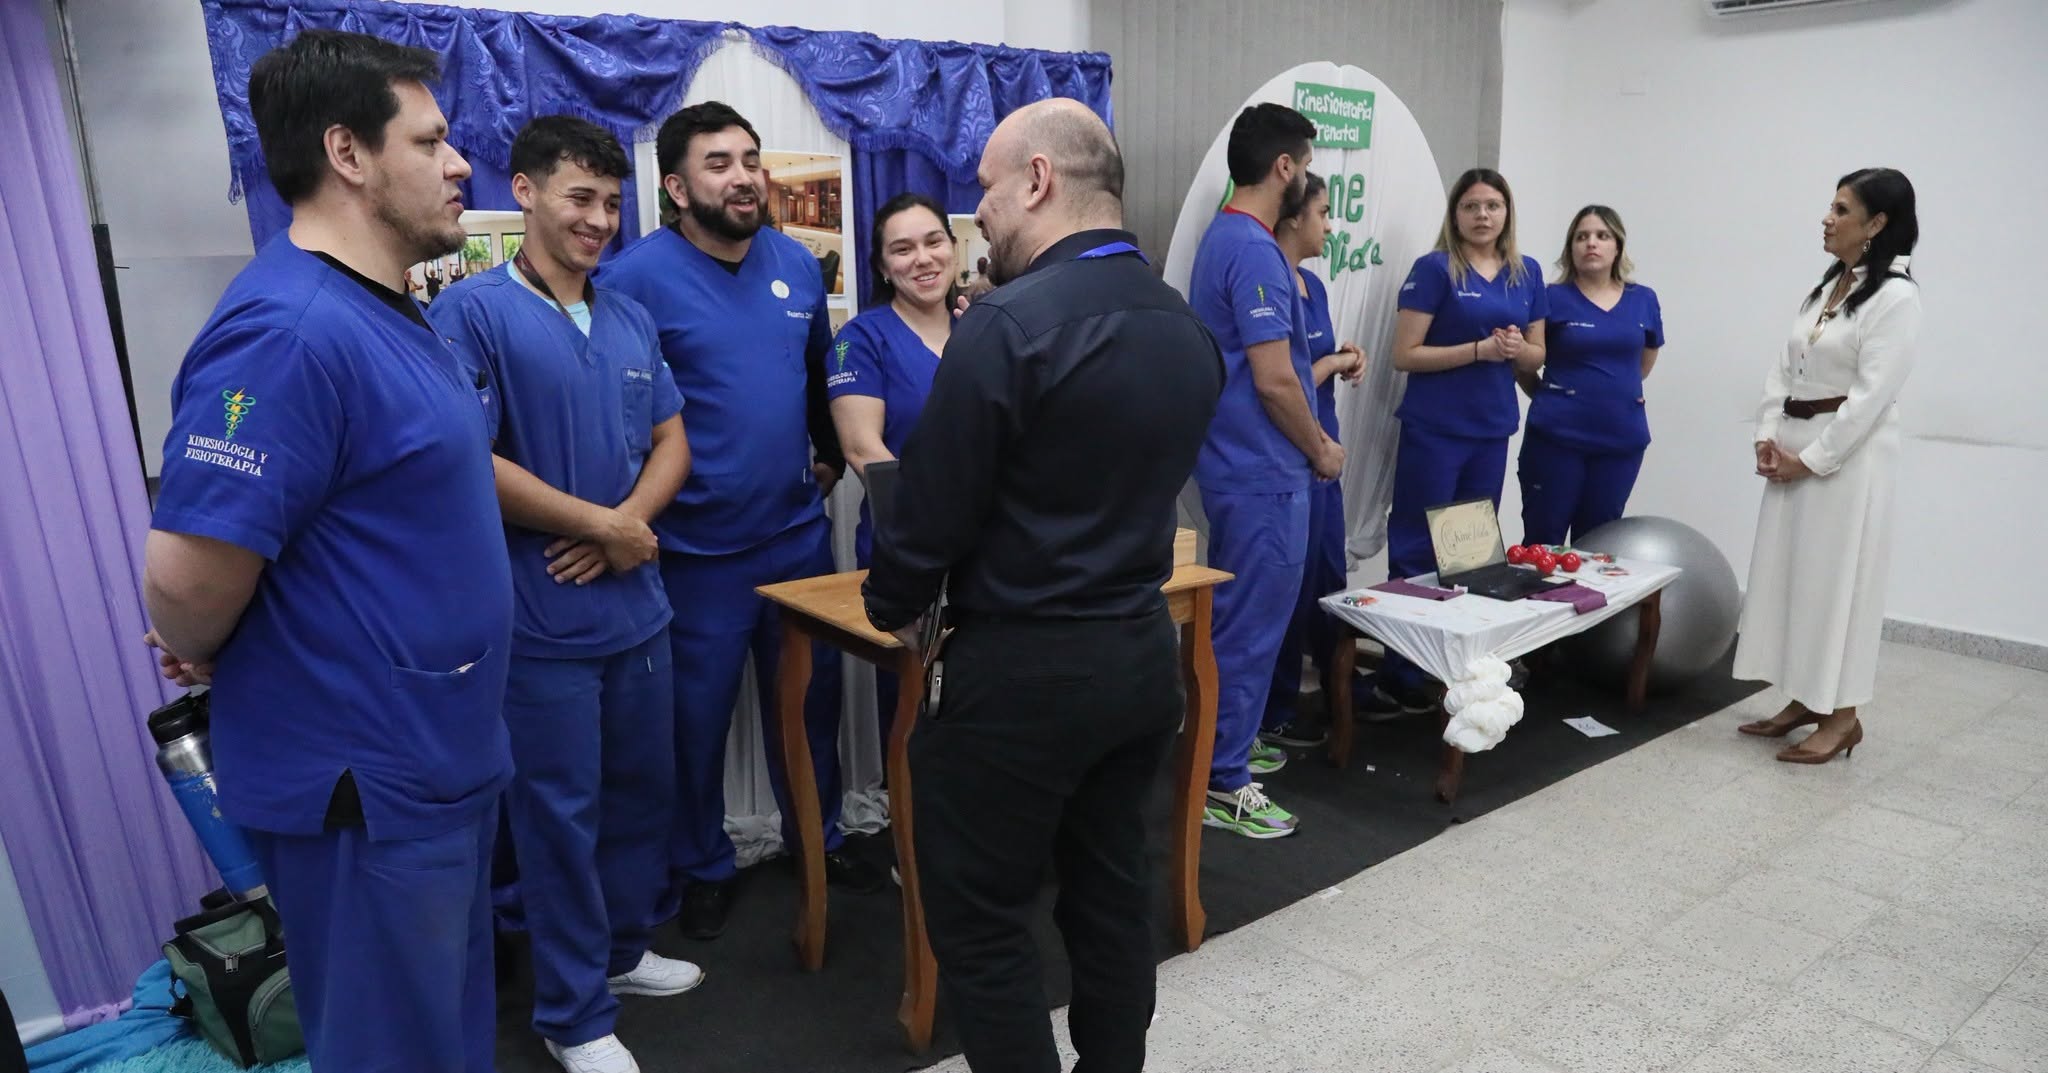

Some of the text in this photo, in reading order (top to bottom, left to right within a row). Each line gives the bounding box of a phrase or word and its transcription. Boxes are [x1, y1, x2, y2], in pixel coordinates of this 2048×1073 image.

[184, 446, 262, 477] FISIOTERAPIA
[187, 434, 268, 464] KINESIOLOGIA Y
